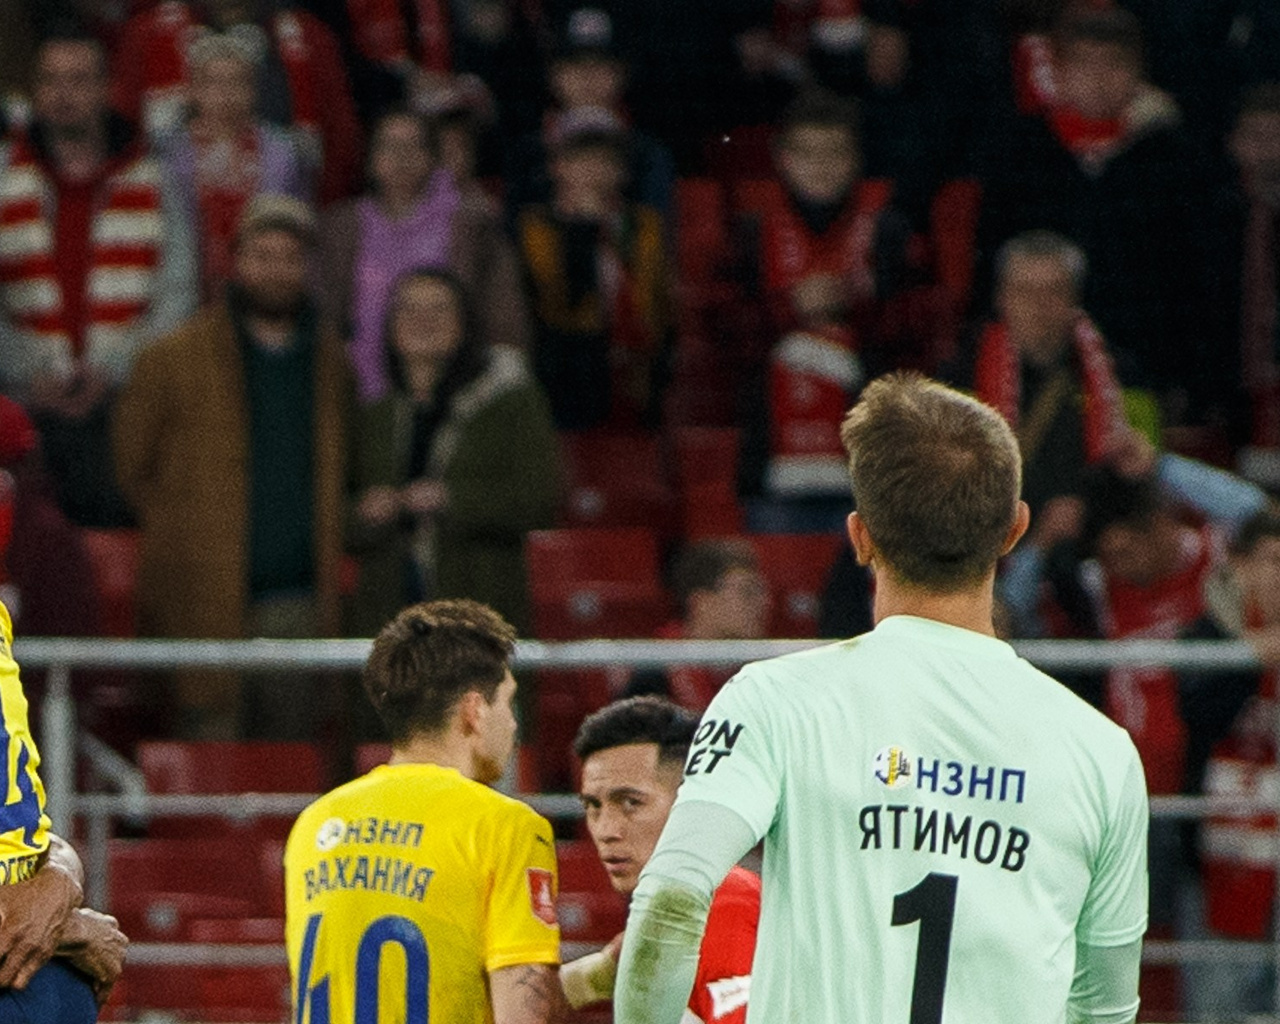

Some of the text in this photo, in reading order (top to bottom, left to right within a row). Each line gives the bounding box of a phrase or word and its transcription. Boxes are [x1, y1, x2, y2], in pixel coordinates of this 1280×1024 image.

[693, 719, 745, 750] ON
[685, 747, 732, 776] ET
[916, 757, 1026, 804] НЗНП
[344, 817, 425, 848] НЗНП
[858, 804, 1032, 873] ЯТИМОВ
[304, 855, 436, 903] ВАХАНИЯ
